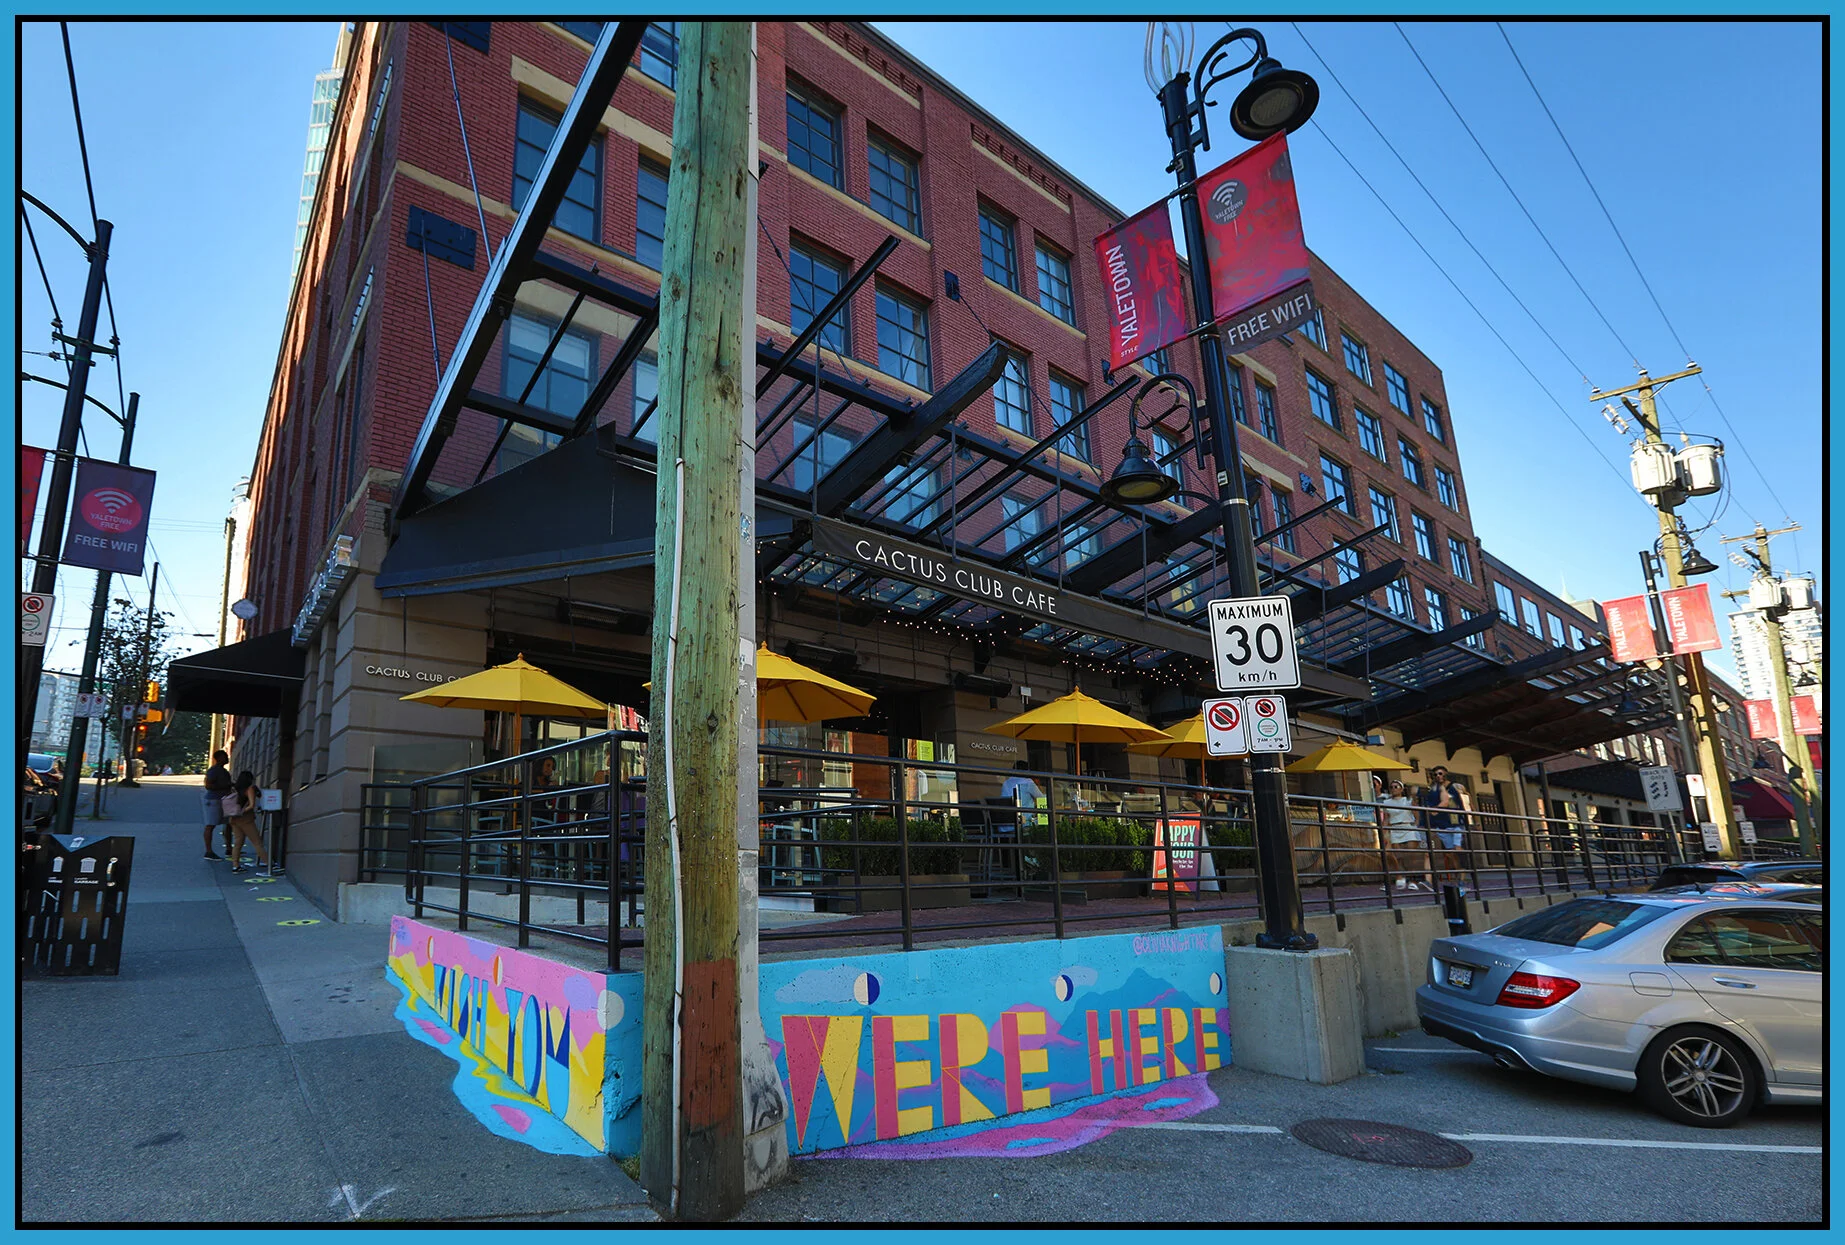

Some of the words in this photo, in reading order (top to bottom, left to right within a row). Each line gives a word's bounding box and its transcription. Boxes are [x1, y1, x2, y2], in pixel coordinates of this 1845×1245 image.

[1215, 200, 1244, 219] YALETOWN
[1224, 211, 1238, 222] FREE
[1105, 245, 1139, 347] YALETOWN
[1227, 312, 1270, 346] FREE
[1271, 293, 1312, 325] WIFI
[1120, 345, 1139, 358] STYLE
[90, 513, 133, 525] YALETOWN
[99, 522, 120, 530] FREE
[74, 534, 109, 548] FREE
[111, 540, 138, 553] WIFI
[855, 540, 947, 582] CACTUS
[955, 569, 1003, 598] CLUB
[1012, 586, 1057, 615] CAFE
[1217, 604, 1284, 620] MAXIMUM
[1667, 597, 1689, 643] YALETOWN
[1608, 607, 1628, 652] YALETOWN
[1225, 623, 1284, 666] 30
[365, 665, 411, 679] CACTUS
[416, 672, 443, 682] CLUB
[1239, 670, 1277, 683] km/h
[1171, 842, 1195, 858] OUR
[781, 1011, 1051, 1150] WERE
[1085, 1007, 1221, 1096] HERE
